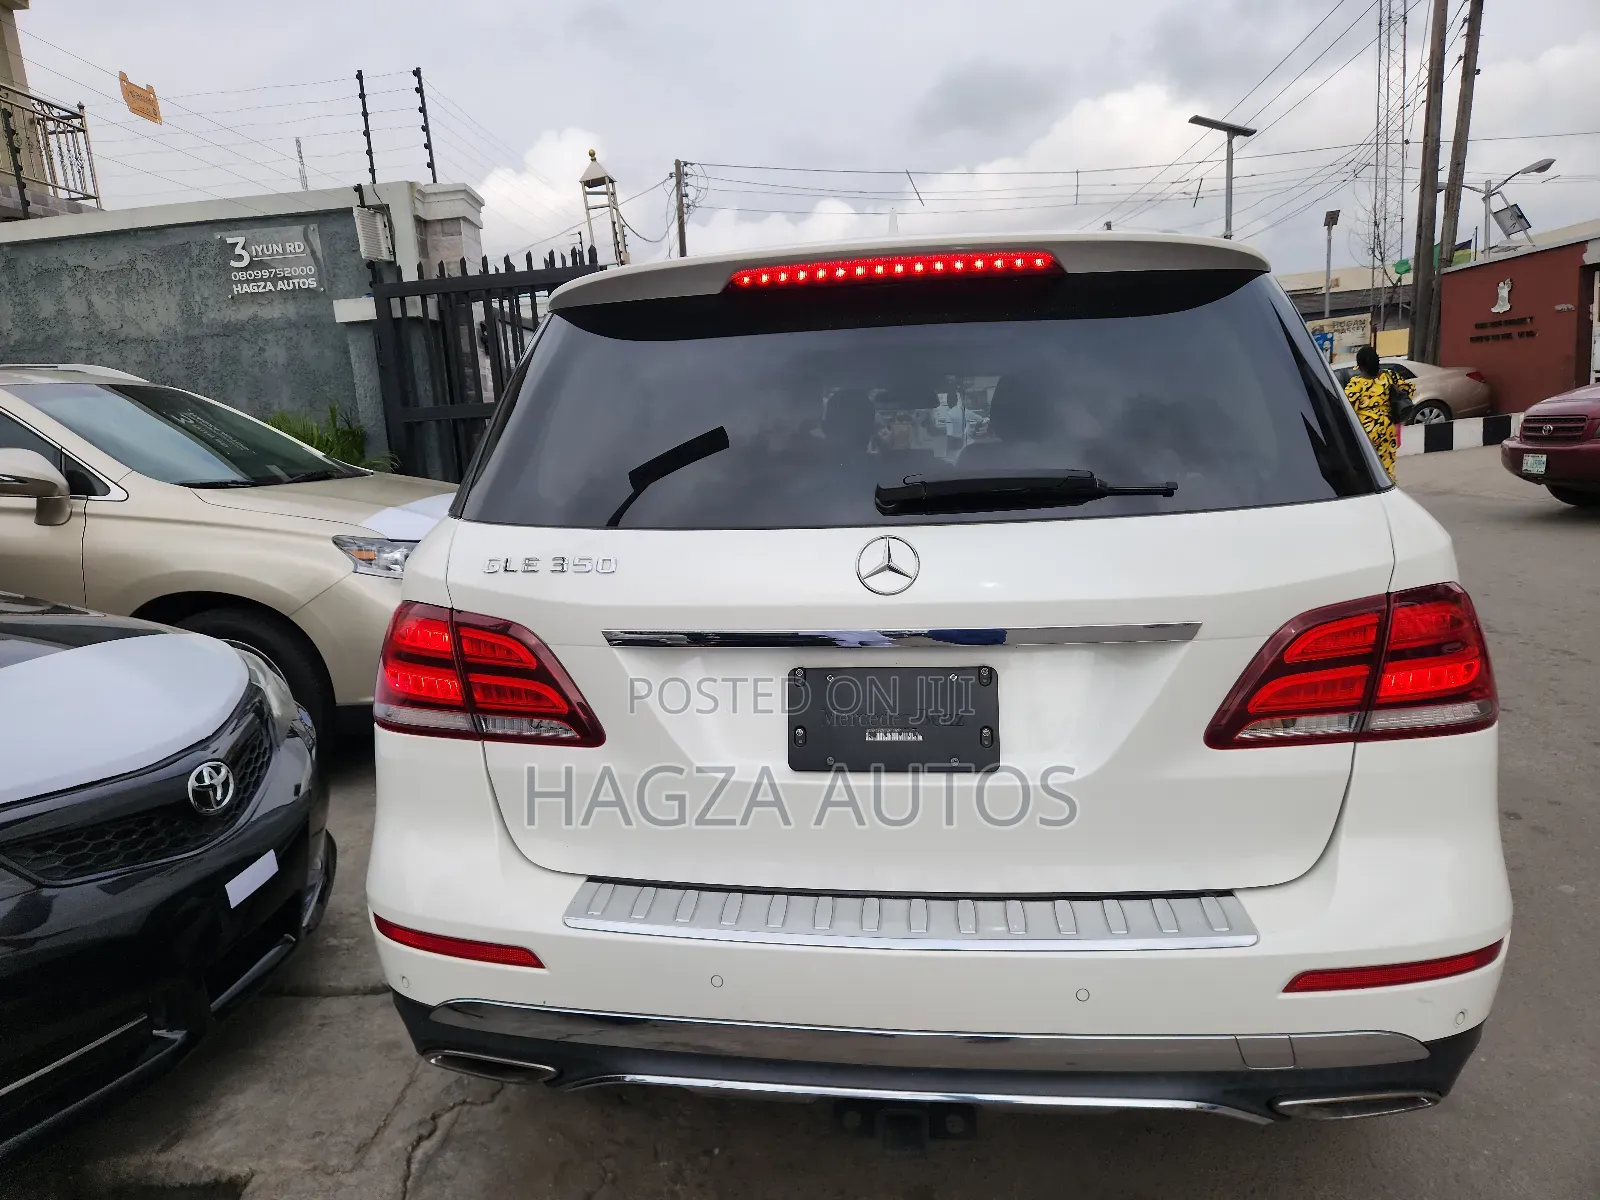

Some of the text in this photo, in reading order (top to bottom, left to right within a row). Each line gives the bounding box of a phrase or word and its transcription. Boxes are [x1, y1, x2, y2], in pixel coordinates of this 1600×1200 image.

[226, 237, 305, 267] 3 IYUN RD
[231, 266, 315, 280] 08099752000
[233, 278, 317, 294] HAGZA AUTOS
[483, 556, 617, 573] GLE 350
